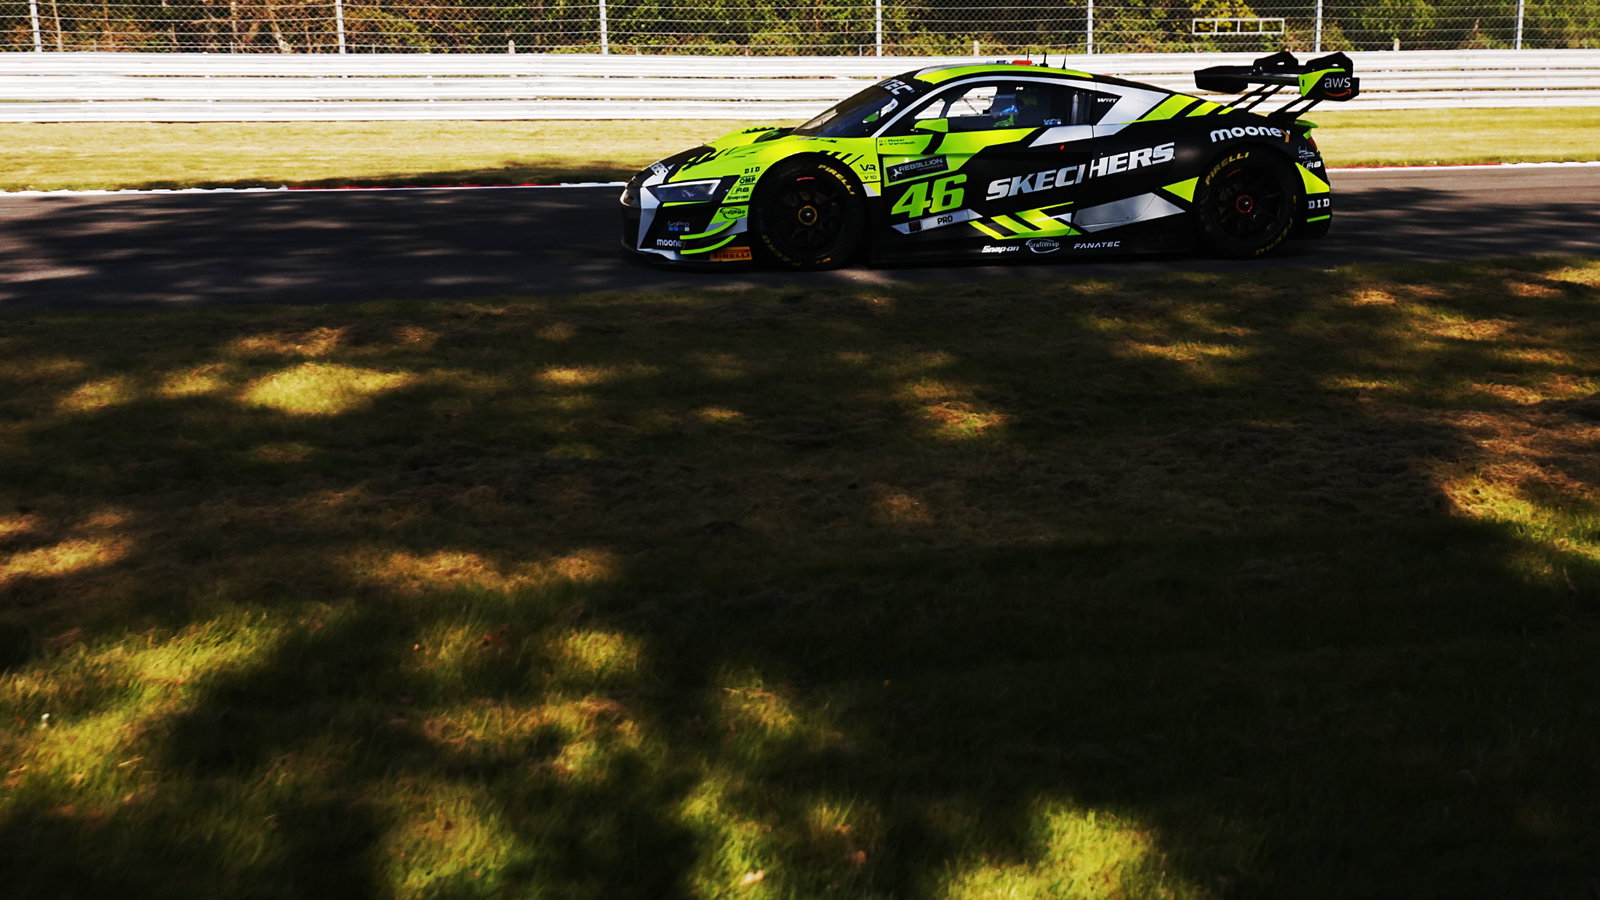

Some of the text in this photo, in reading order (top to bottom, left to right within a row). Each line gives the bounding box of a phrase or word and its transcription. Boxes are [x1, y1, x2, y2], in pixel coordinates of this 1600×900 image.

[1324, 77, 1351, 89] aws
[1210, 126, 1290, 143] mooney
[898, 158, 943, 172] REBELLION
[986, 142, 1176, 201] SKECHERS
[1204, 152, 1250, 187] PIRELLI
[891, 174, 967, 218] 46
[1308, 198, 1330, 209] DID
[937, 216, 953, 225] PRO
[981, 245, 1020, 253] Snap-on
[1074, 240, 1121, 249] FANATEC
